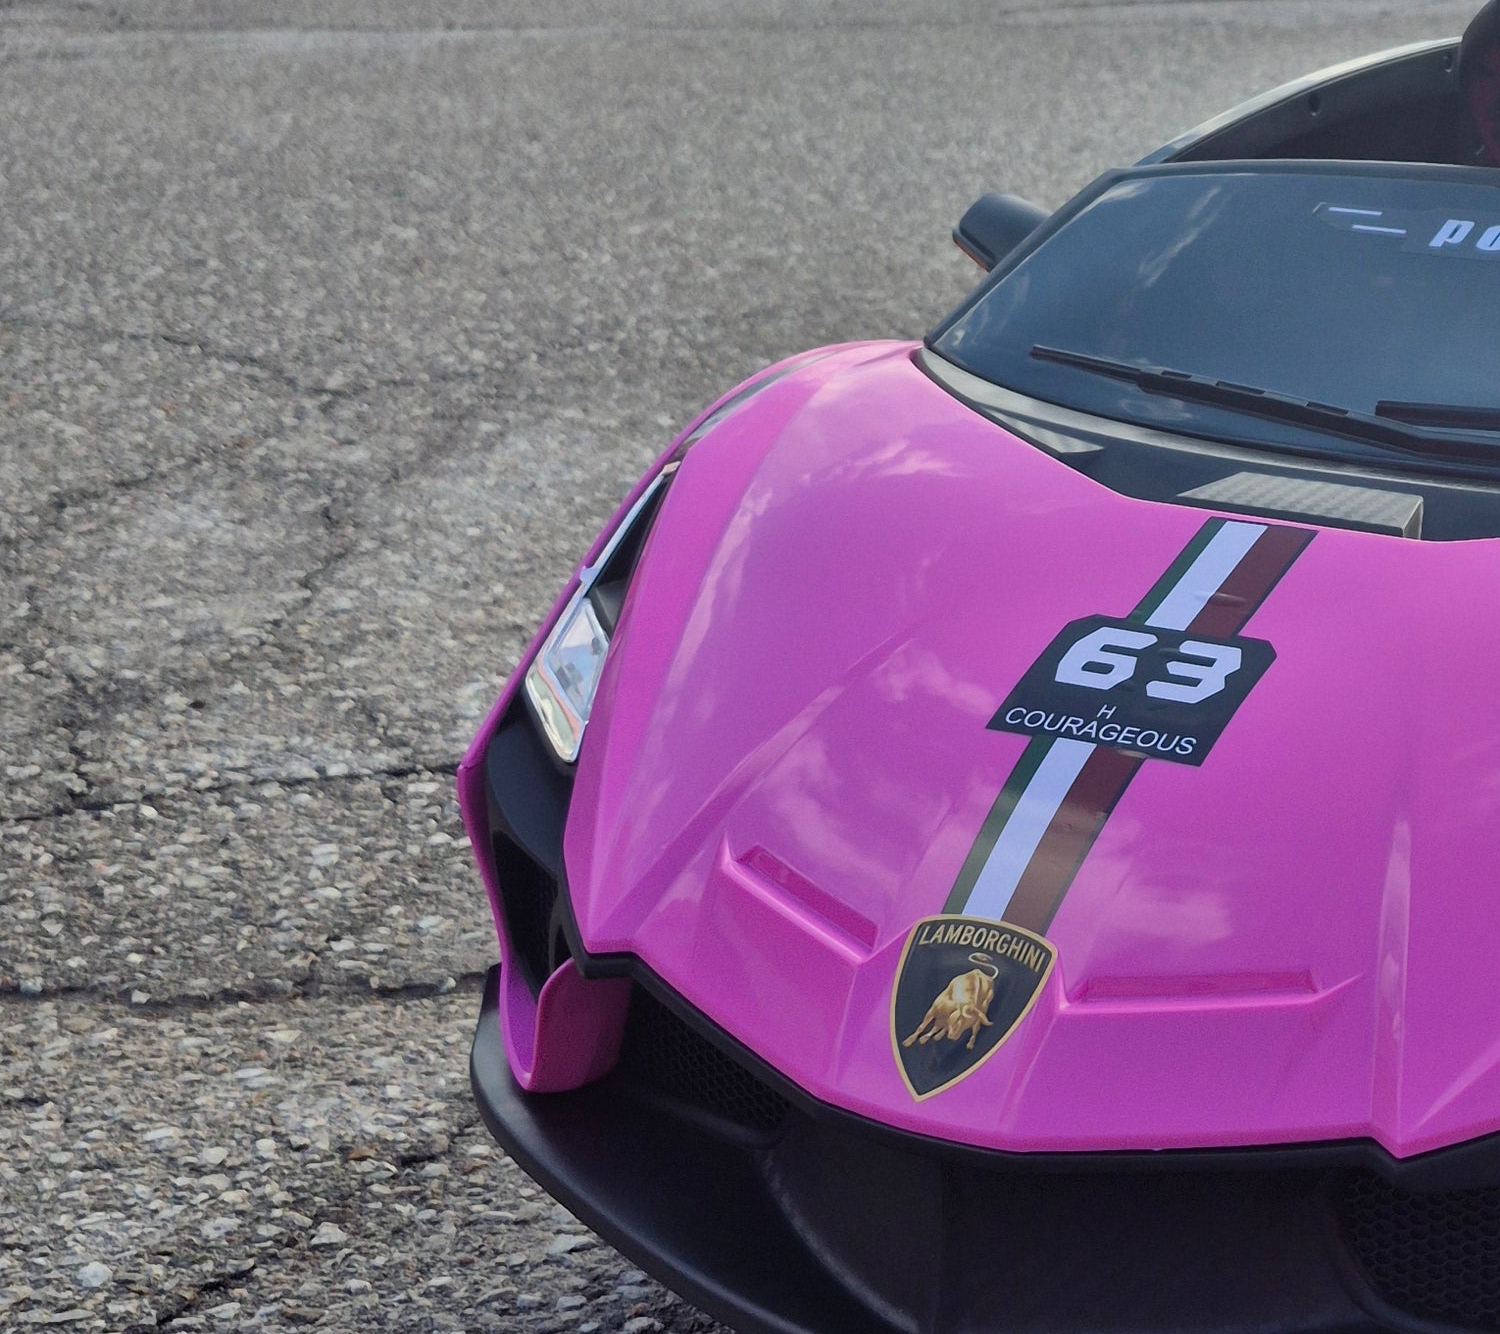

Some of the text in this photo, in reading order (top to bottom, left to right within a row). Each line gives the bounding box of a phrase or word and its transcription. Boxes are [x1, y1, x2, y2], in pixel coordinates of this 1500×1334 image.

[1054, 625, 1242, 704] 63
[1005, 706, 1197, 755] COURAGEOUS
[1096, 704, 1117, 719] H
[918, 923, 1047, 973] LAMBORGHINI
